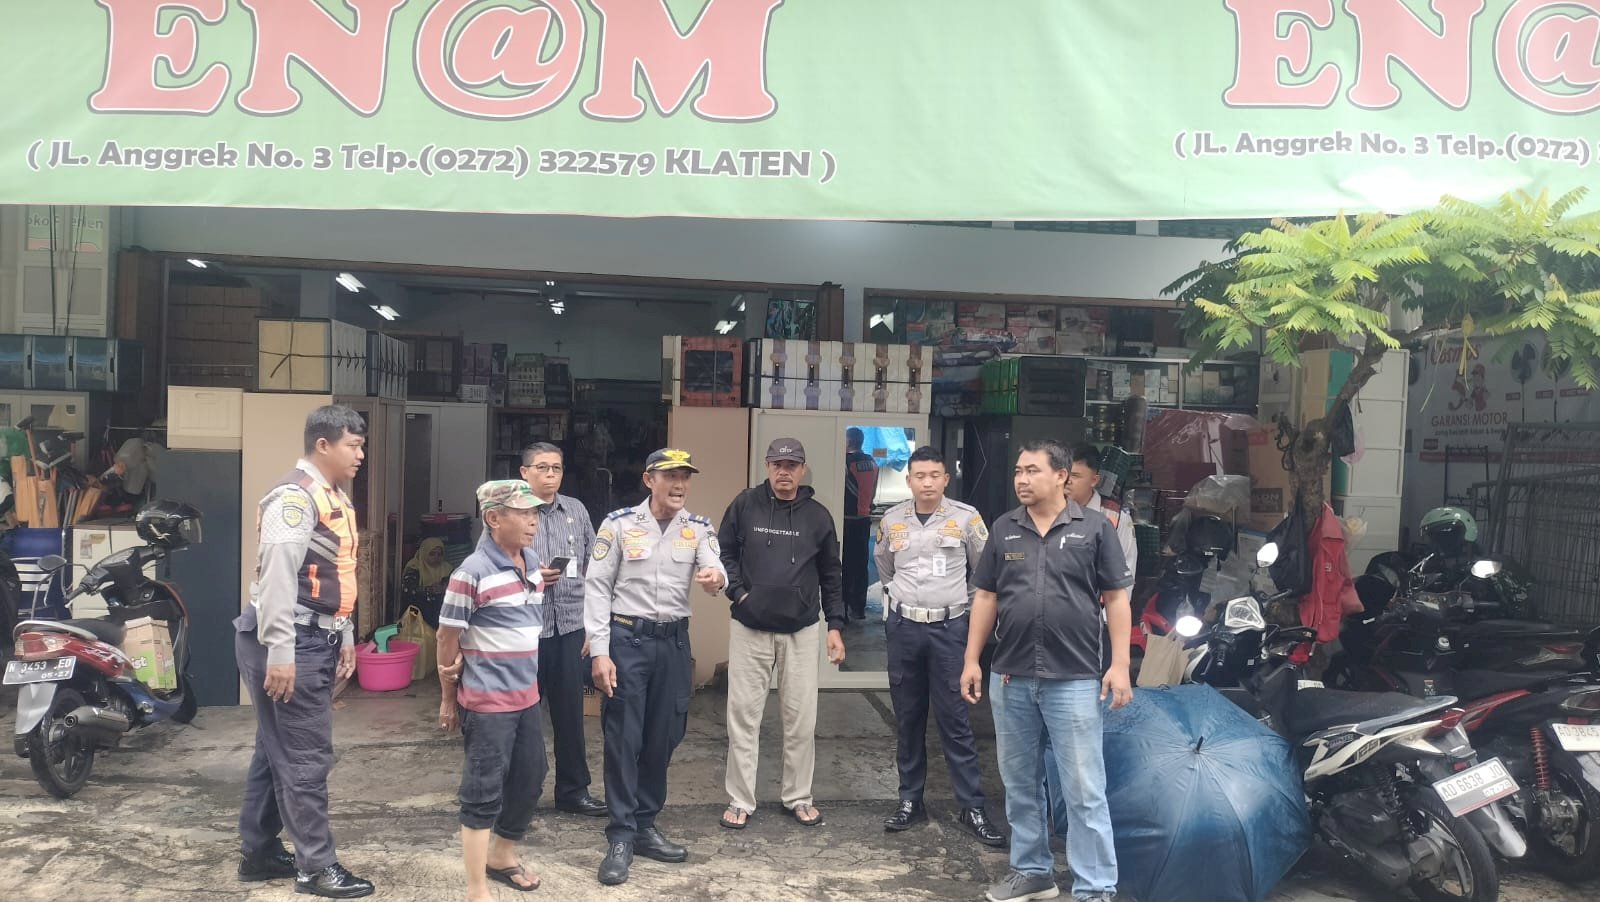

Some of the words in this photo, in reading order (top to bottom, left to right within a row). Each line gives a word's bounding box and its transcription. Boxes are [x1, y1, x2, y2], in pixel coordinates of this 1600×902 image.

[1234, 130, 1354, 157] Anggrek
[1360, 132, 1407, 156] No.
[1414, 136, 1430, 155] 3
[98, 140, 239, 171] Anggrek
[246, 142, 304, 169] No.
[312, 146, 333, 169] 3
[539, 149, 657, 177] 322579
[665, 148, 813, 178] KLATEN
[1431, 413, 1470, 427] GARANSI
[1472, 411, 1508, 426] MOTOR
[21, 661, 47, 673] 3453
[1456, 772, 1485, 792] 6638
